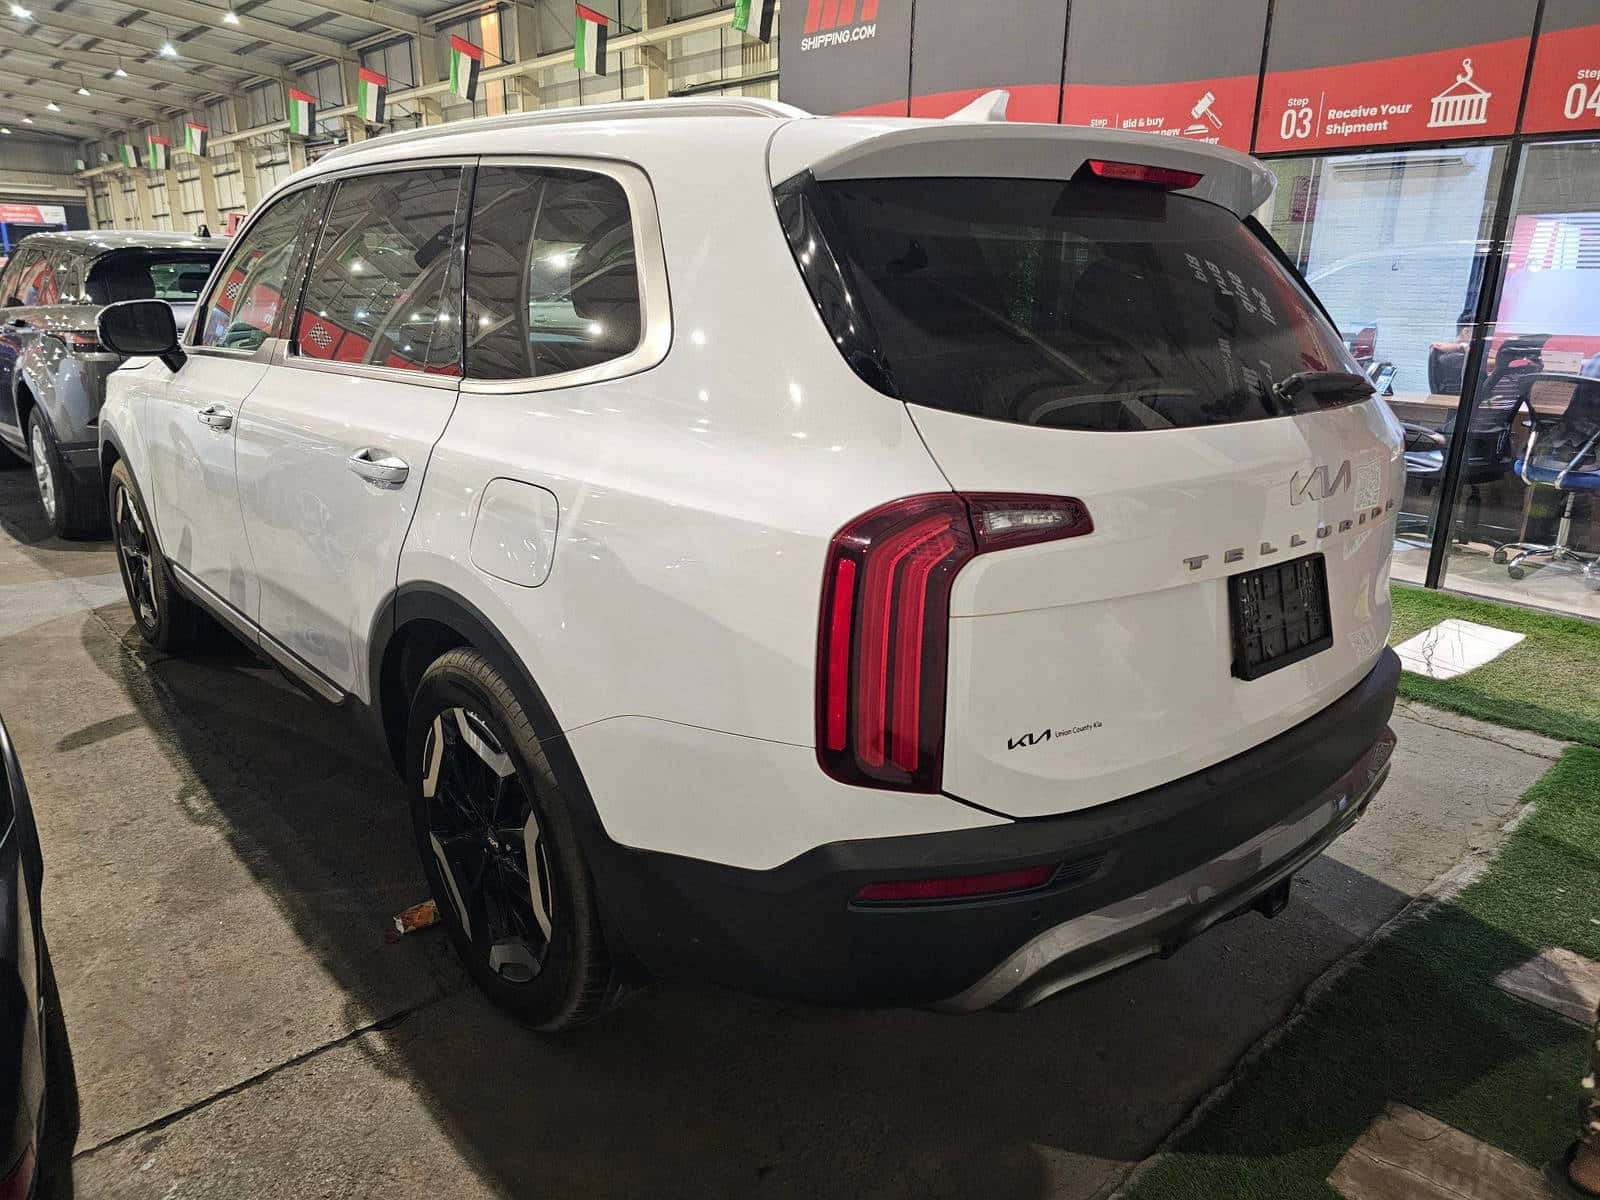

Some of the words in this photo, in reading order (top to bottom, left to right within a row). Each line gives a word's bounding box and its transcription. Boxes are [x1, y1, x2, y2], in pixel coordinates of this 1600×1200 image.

[801, 23, 877, 51] SHIPPING.COM
[1287, 97, 1310, 108] Step
[1327, 105, 1378, 121] Receive
[1380, 102, 1412, 116] Your
[1122, 118, 1137, 128] Bid
[1138, 118, 1145, 127] &
[1146, 117, 1164, 128] buy
[1280, 108, 1313, 140] 03
[1326, 119, 1389, 137] Shipment
